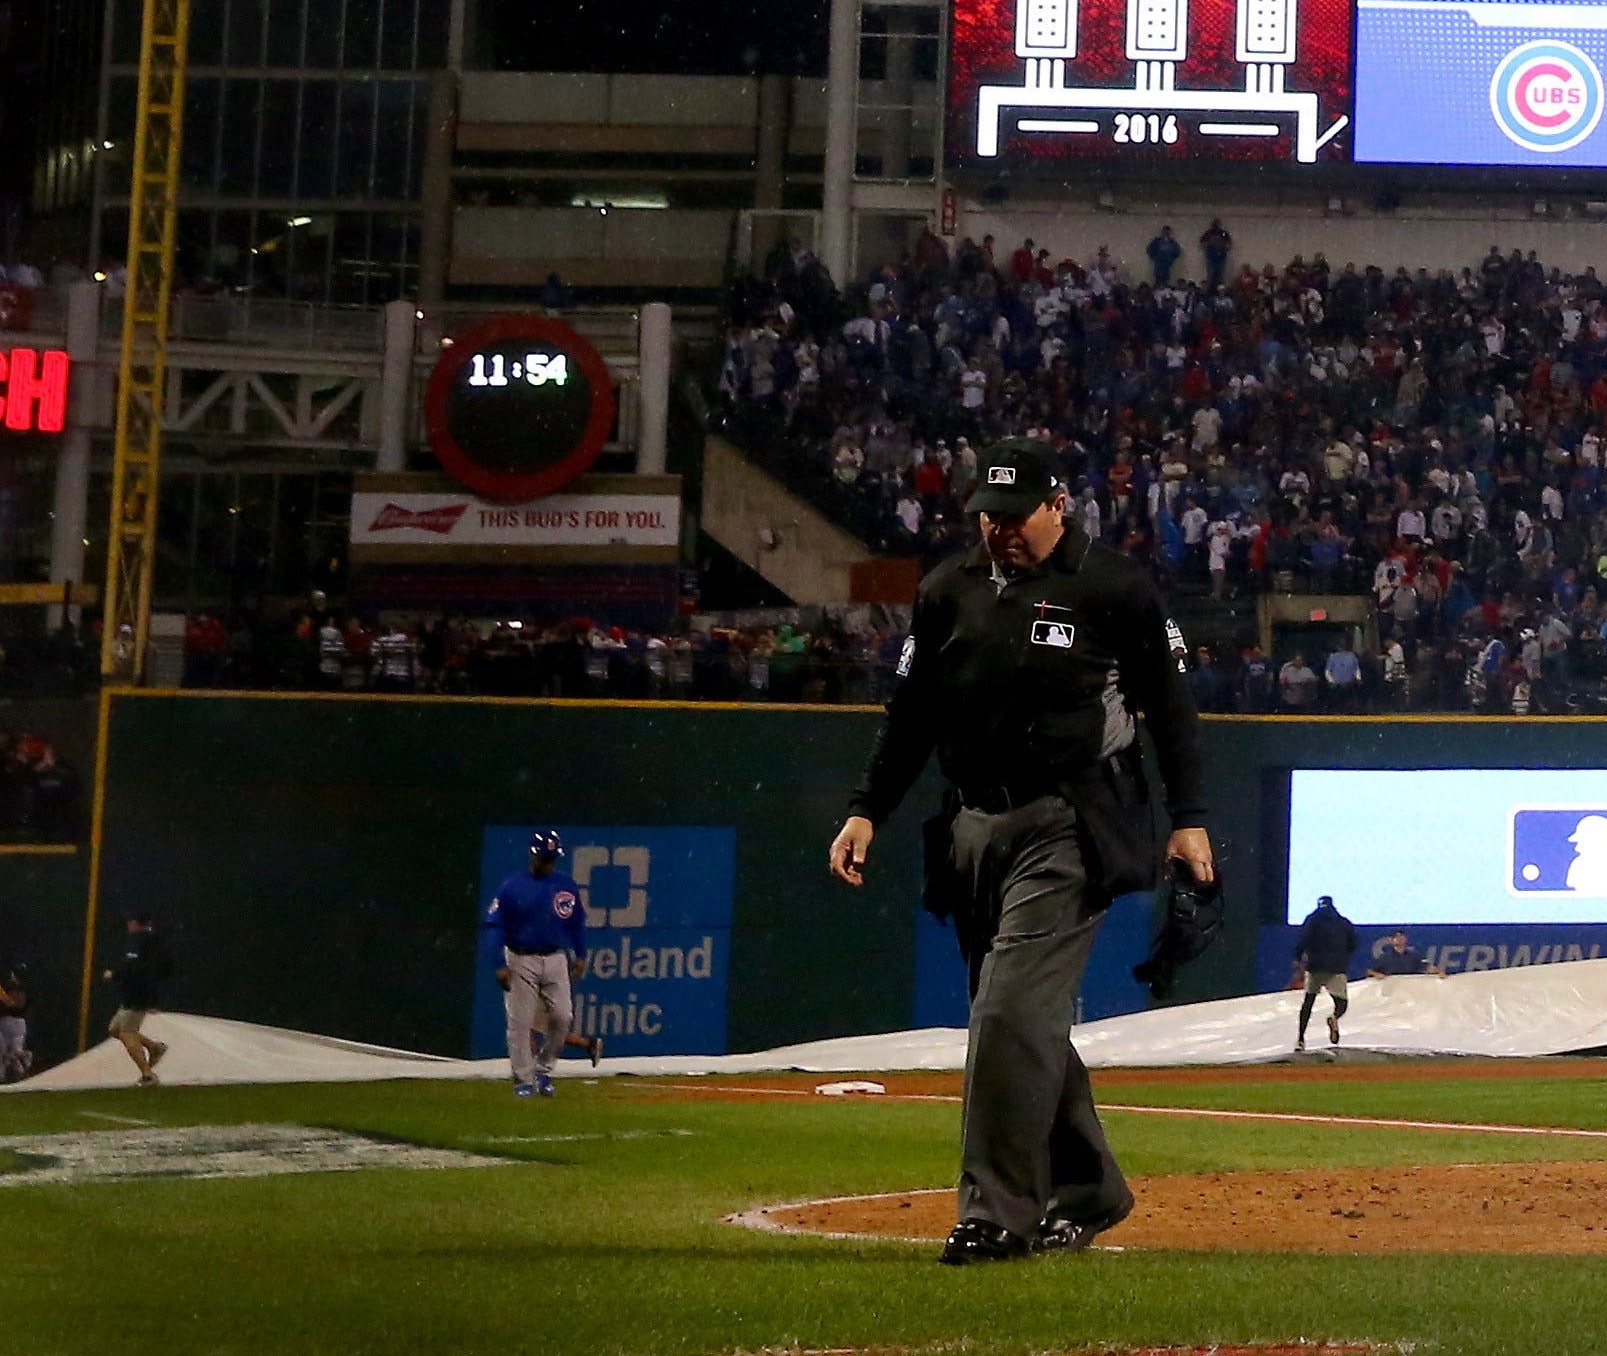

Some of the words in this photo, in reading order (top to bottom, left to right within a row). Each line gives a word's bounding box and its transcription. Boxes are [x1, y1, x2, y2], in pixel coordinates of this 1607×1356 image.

[1115, 115, 1177, 143] 2016
[469, 354, 567, 385] 11:54
[477, 509, 519, 528] THIS
[584, 510, 619, 528] FOR
[625, 511, 666, 529] YOU.
[570, 936, 713, 979] veland
[572, 993, 663, 1036] linic
